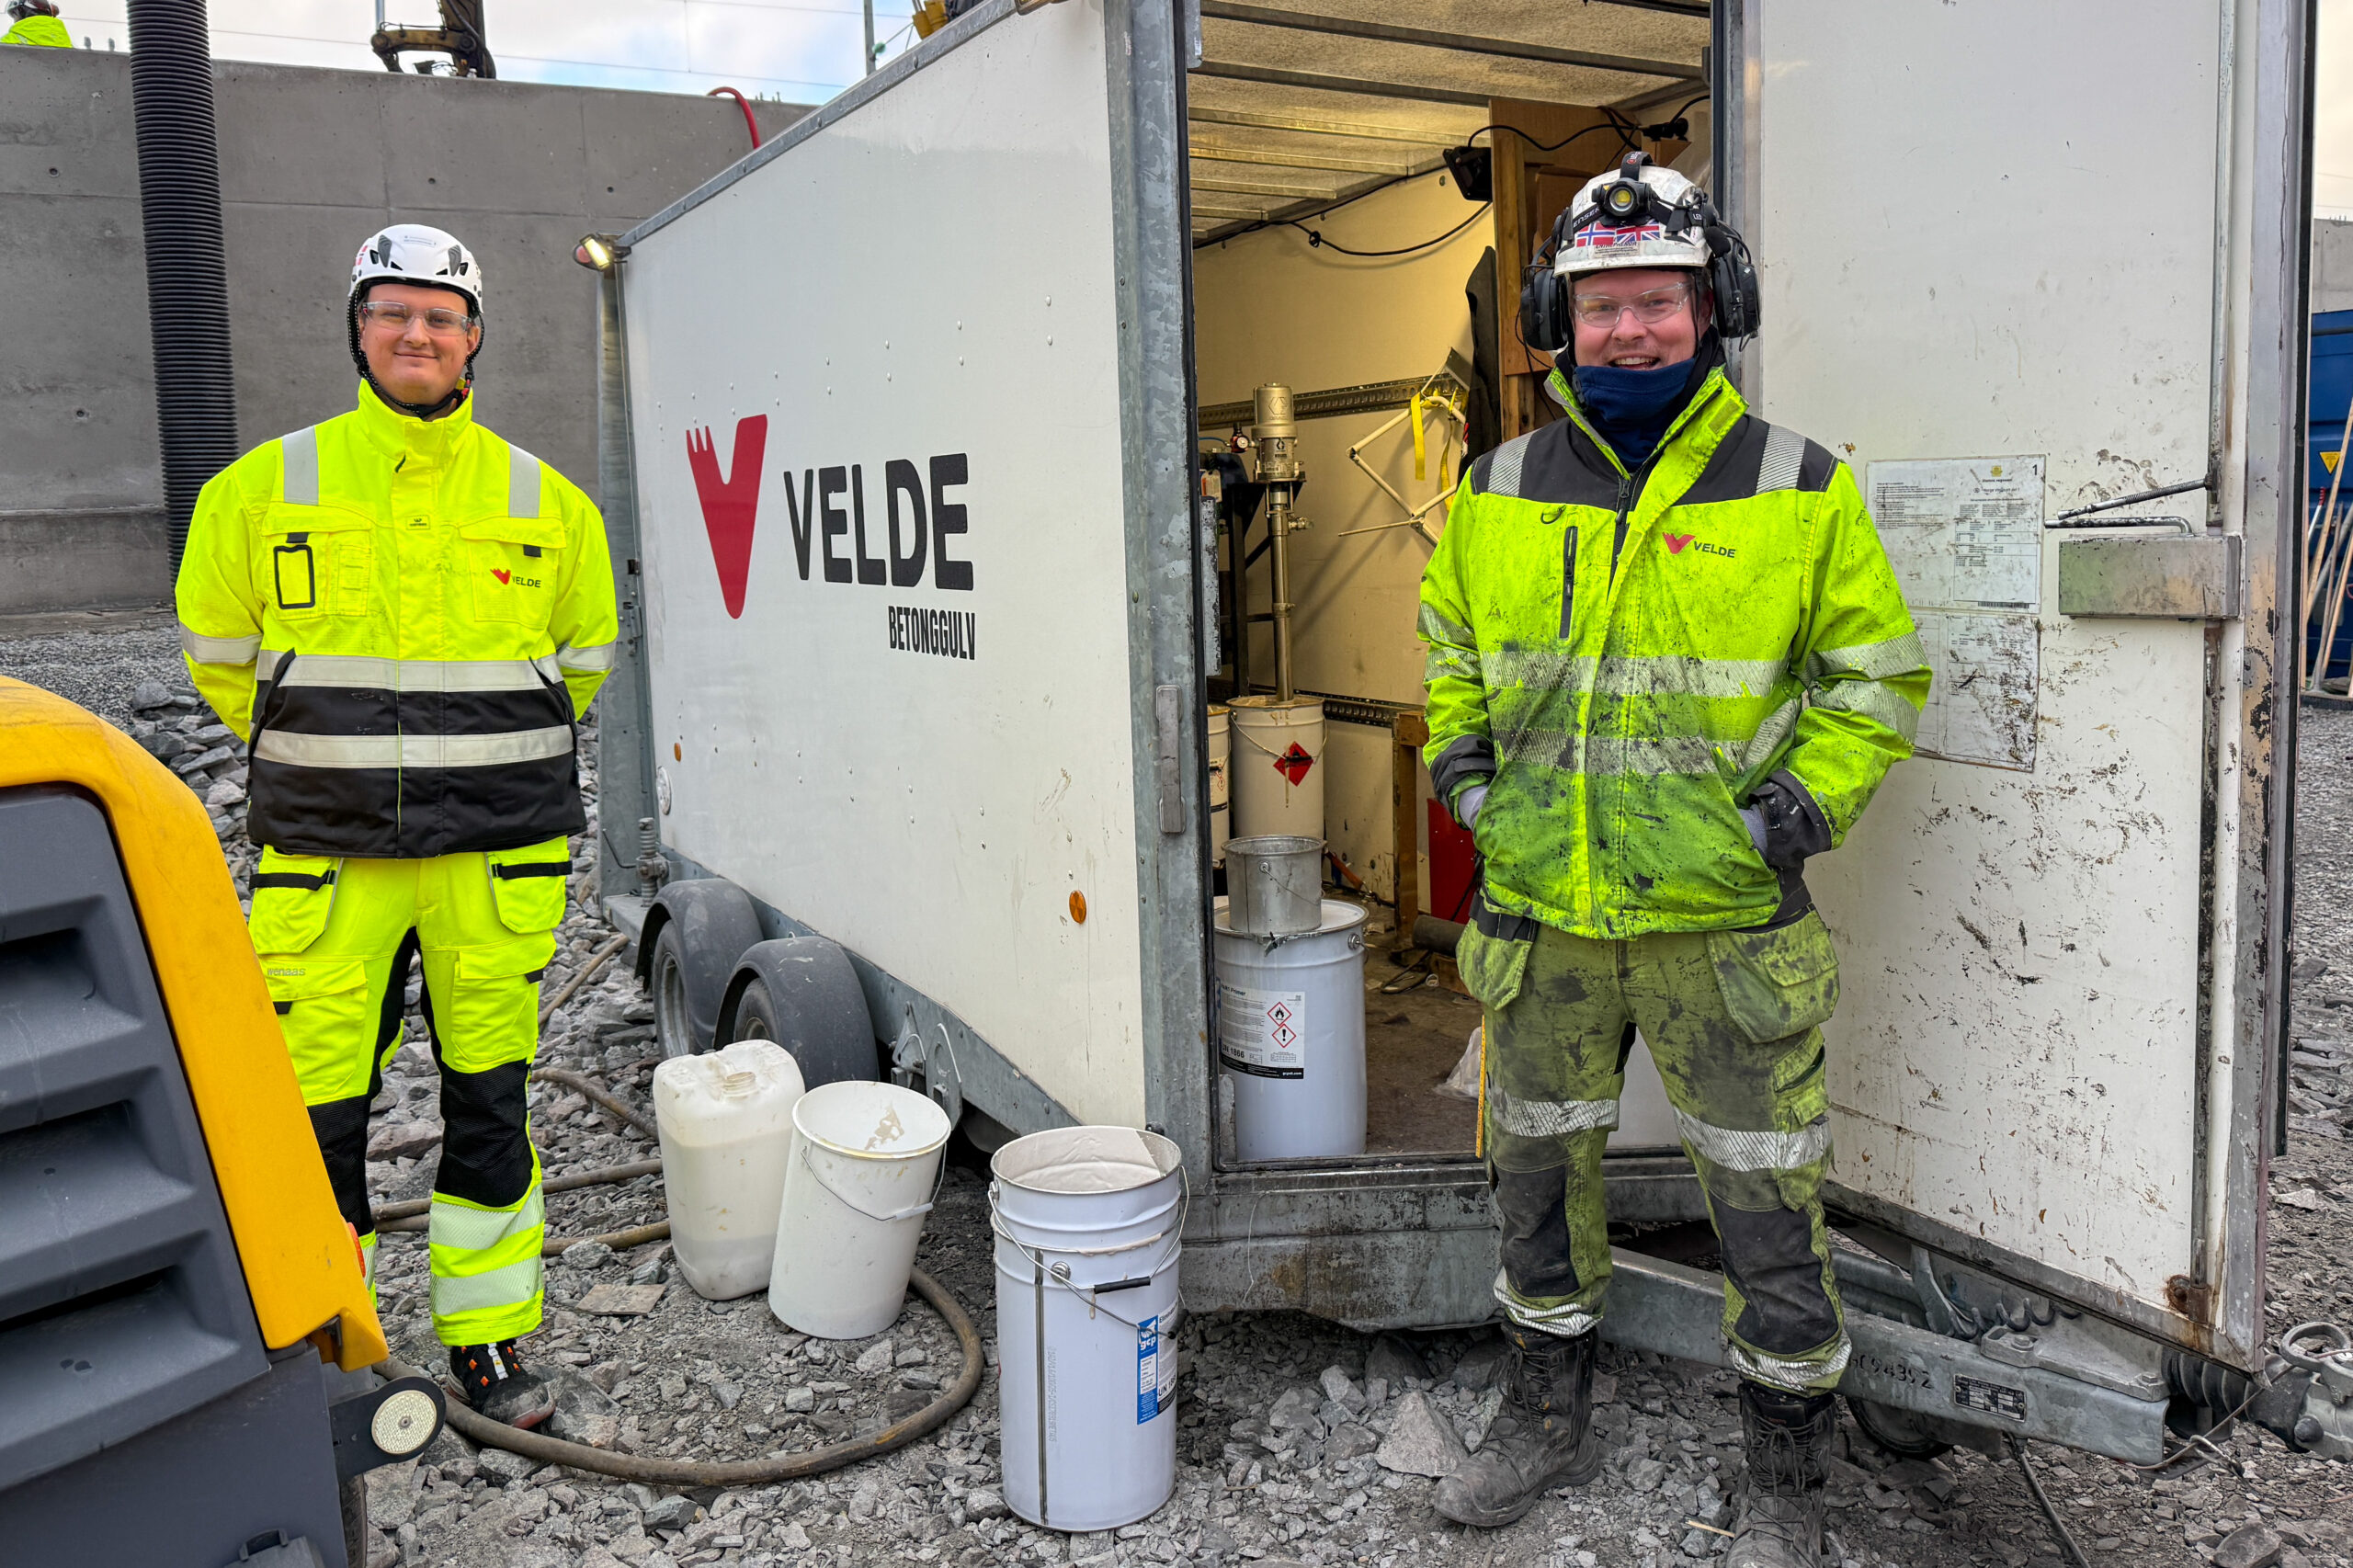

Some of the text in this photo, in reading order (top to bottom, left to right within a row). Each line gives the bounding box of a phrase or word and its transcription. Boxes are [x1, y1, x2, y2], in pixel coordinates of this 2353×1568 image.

[2031, 463, 2039, 476] 1
[783, 452, 974, 591] VELDE
[1693, 540, 1736, 559] VELDE
[887, 605, 976, 661] BETONGGULV
[267, 968, 306, 976] wenaas
[1140, 1335, 1156, 1351] gcp
